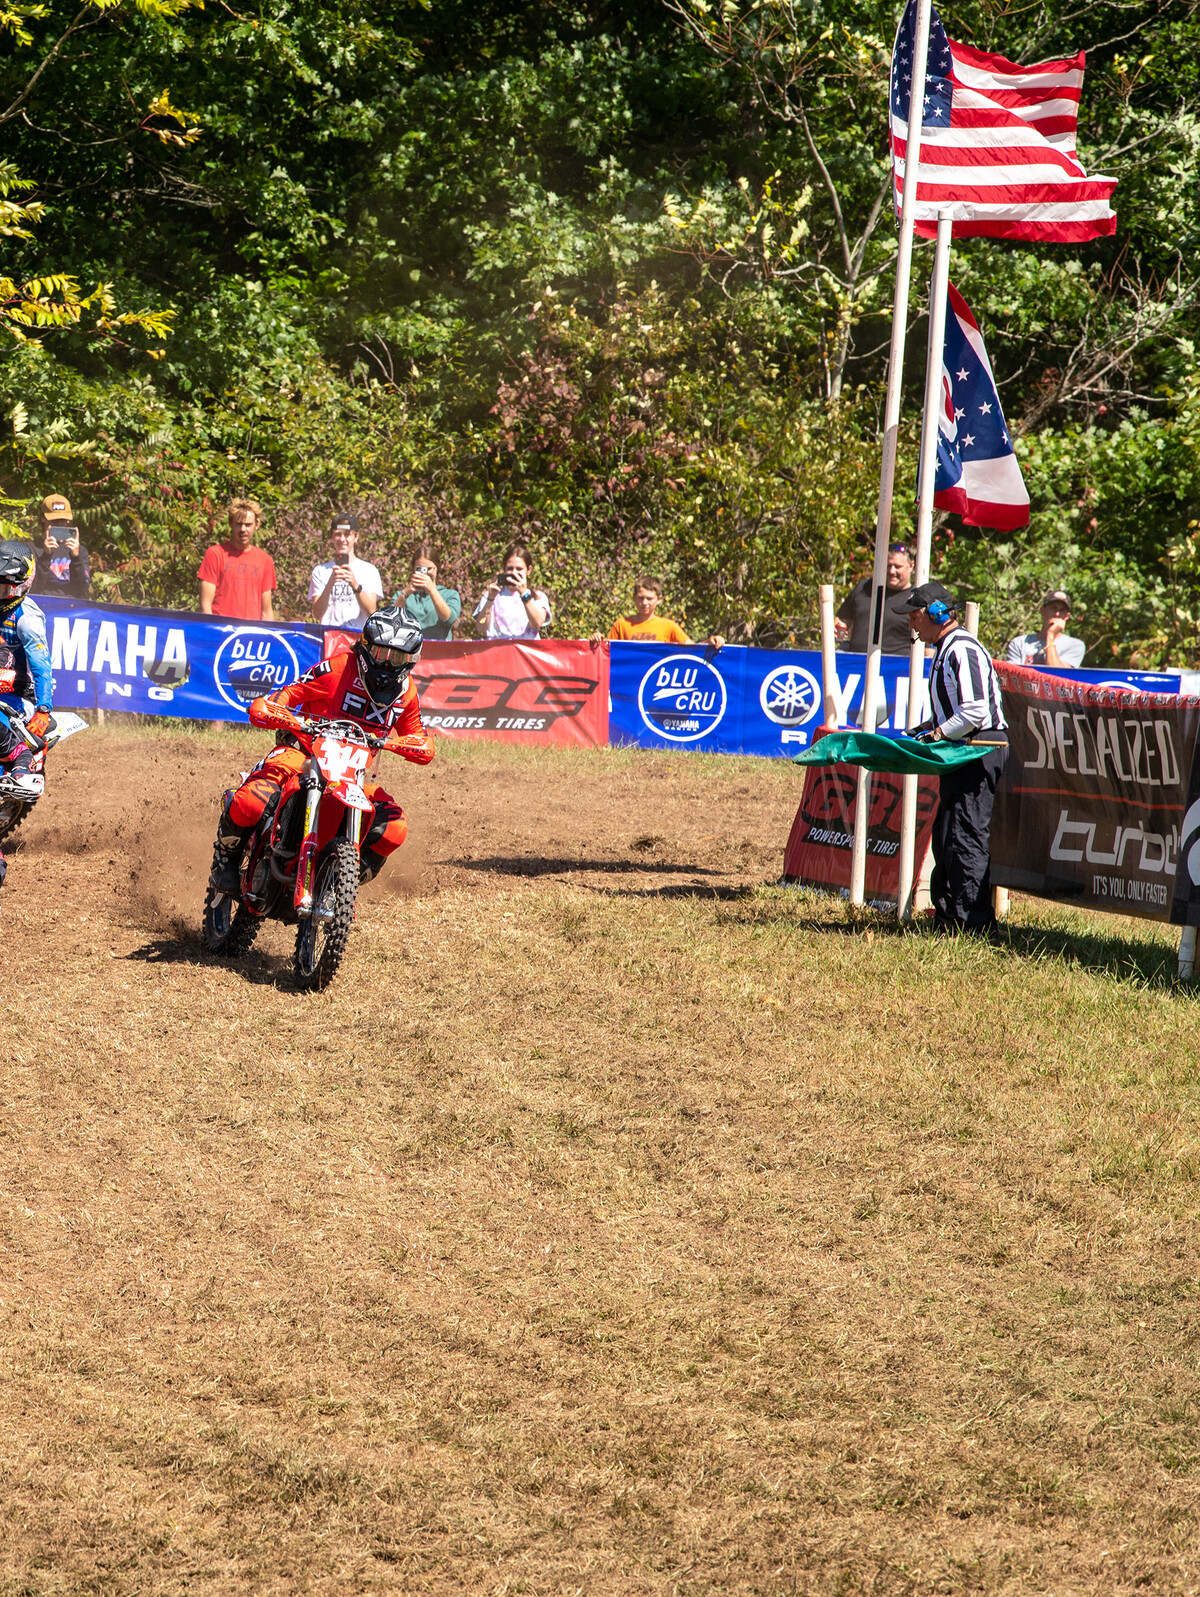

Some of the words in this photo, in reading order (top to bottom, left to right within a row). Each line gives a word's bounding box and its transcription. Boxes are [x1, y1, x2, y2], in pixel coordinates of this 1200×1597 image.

[51, 616, 188, 683] MAHA
[412, 674, 600, 718] BC
[495, 717, 547, 730] TIRES
[671, 719, 700, 730] YAMAHA
[1023, 705, 1182, 787] SPECIALIZED
[872, 838, 900, 855] TIRES
[1093, 874, 1108, 896] IT'S
[1108, 876, 1127, 901] YOU,
[1127, 879, 1146, 902] ONLY
[1145, 882, 1168, 906] FASTER
